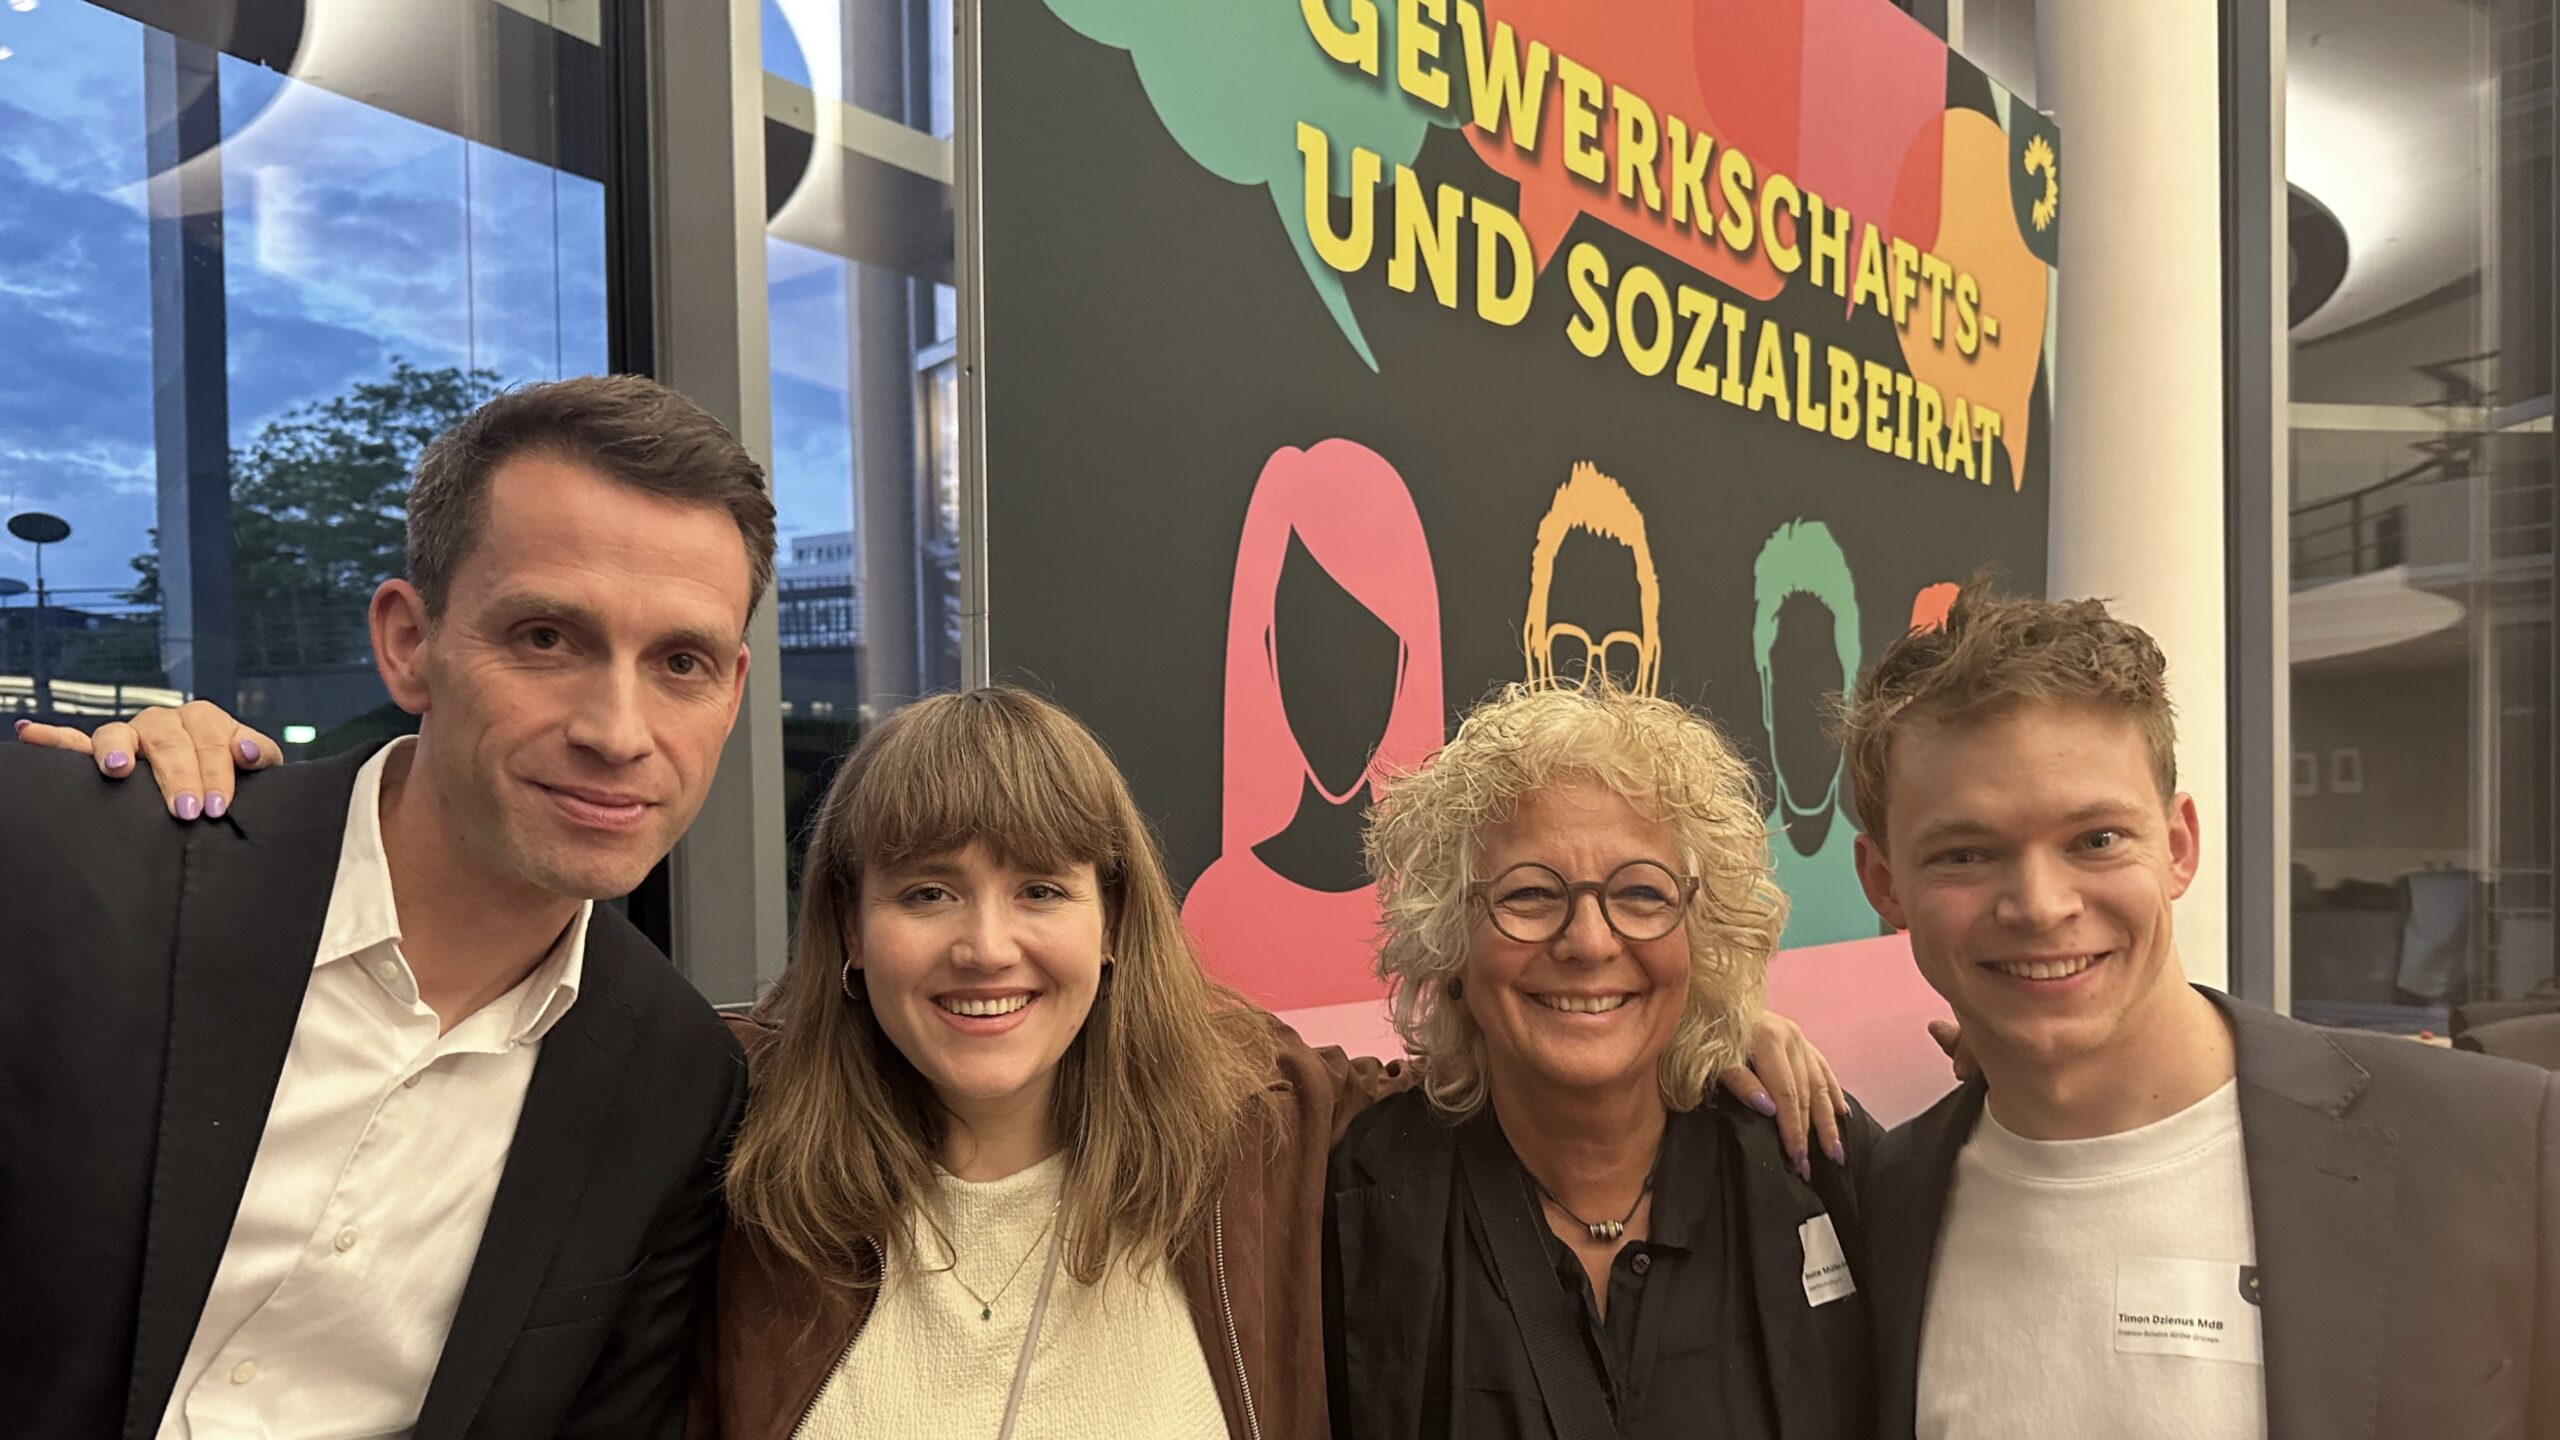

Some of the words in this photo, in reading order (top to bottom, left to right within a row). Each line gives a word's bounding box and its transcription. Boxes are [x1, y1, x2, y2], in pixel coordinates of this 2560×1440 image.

[1297, 121, 1535, 326] UND
[1566, 242, 2001, 486] SOZIALBEIRAT
[1301, 0, 1998, 354] GEWERKSCHAFTS-
[2118, 1313, 2150, 1324] Timon
[2152, 1314, 2194, 1326] Dzienus
[2197, 1318, 2224, 1330] MdB
